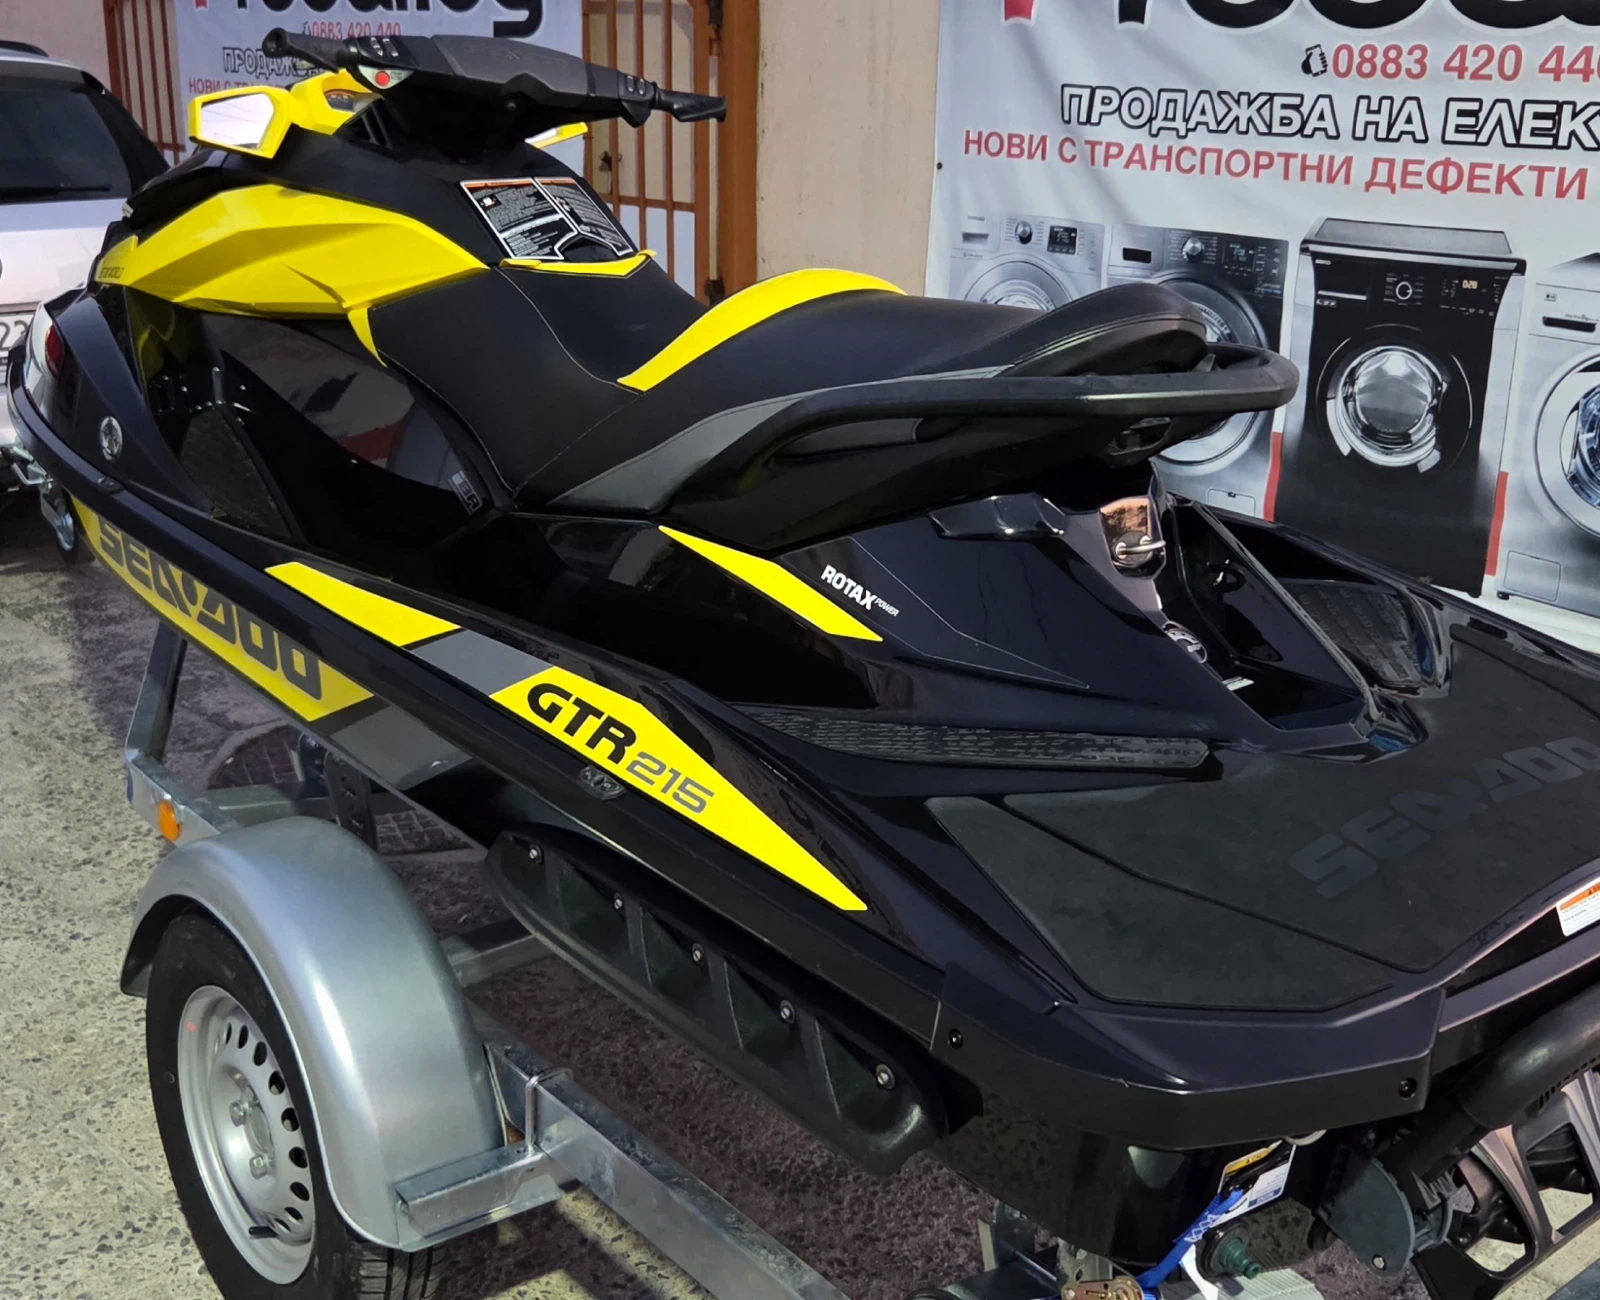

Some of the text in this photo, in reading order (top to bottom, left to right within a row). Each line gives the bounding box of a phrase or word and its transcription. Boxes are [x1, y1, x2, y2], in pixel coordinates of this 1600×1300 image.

[1332, 43, 1600, 83] 0883 420 44
[1061, 84, 1340, 139] ПРОДАЖБА
[1352, 95, 1429, 144] НА
[964, 130, 1588, 200] НОВИ С ТРАНСПОРТНИ ДЕФЕКТИ
[821, 564, 900, 617] ROTAX POWER
[527, 683, 715, 814] GTR 215
